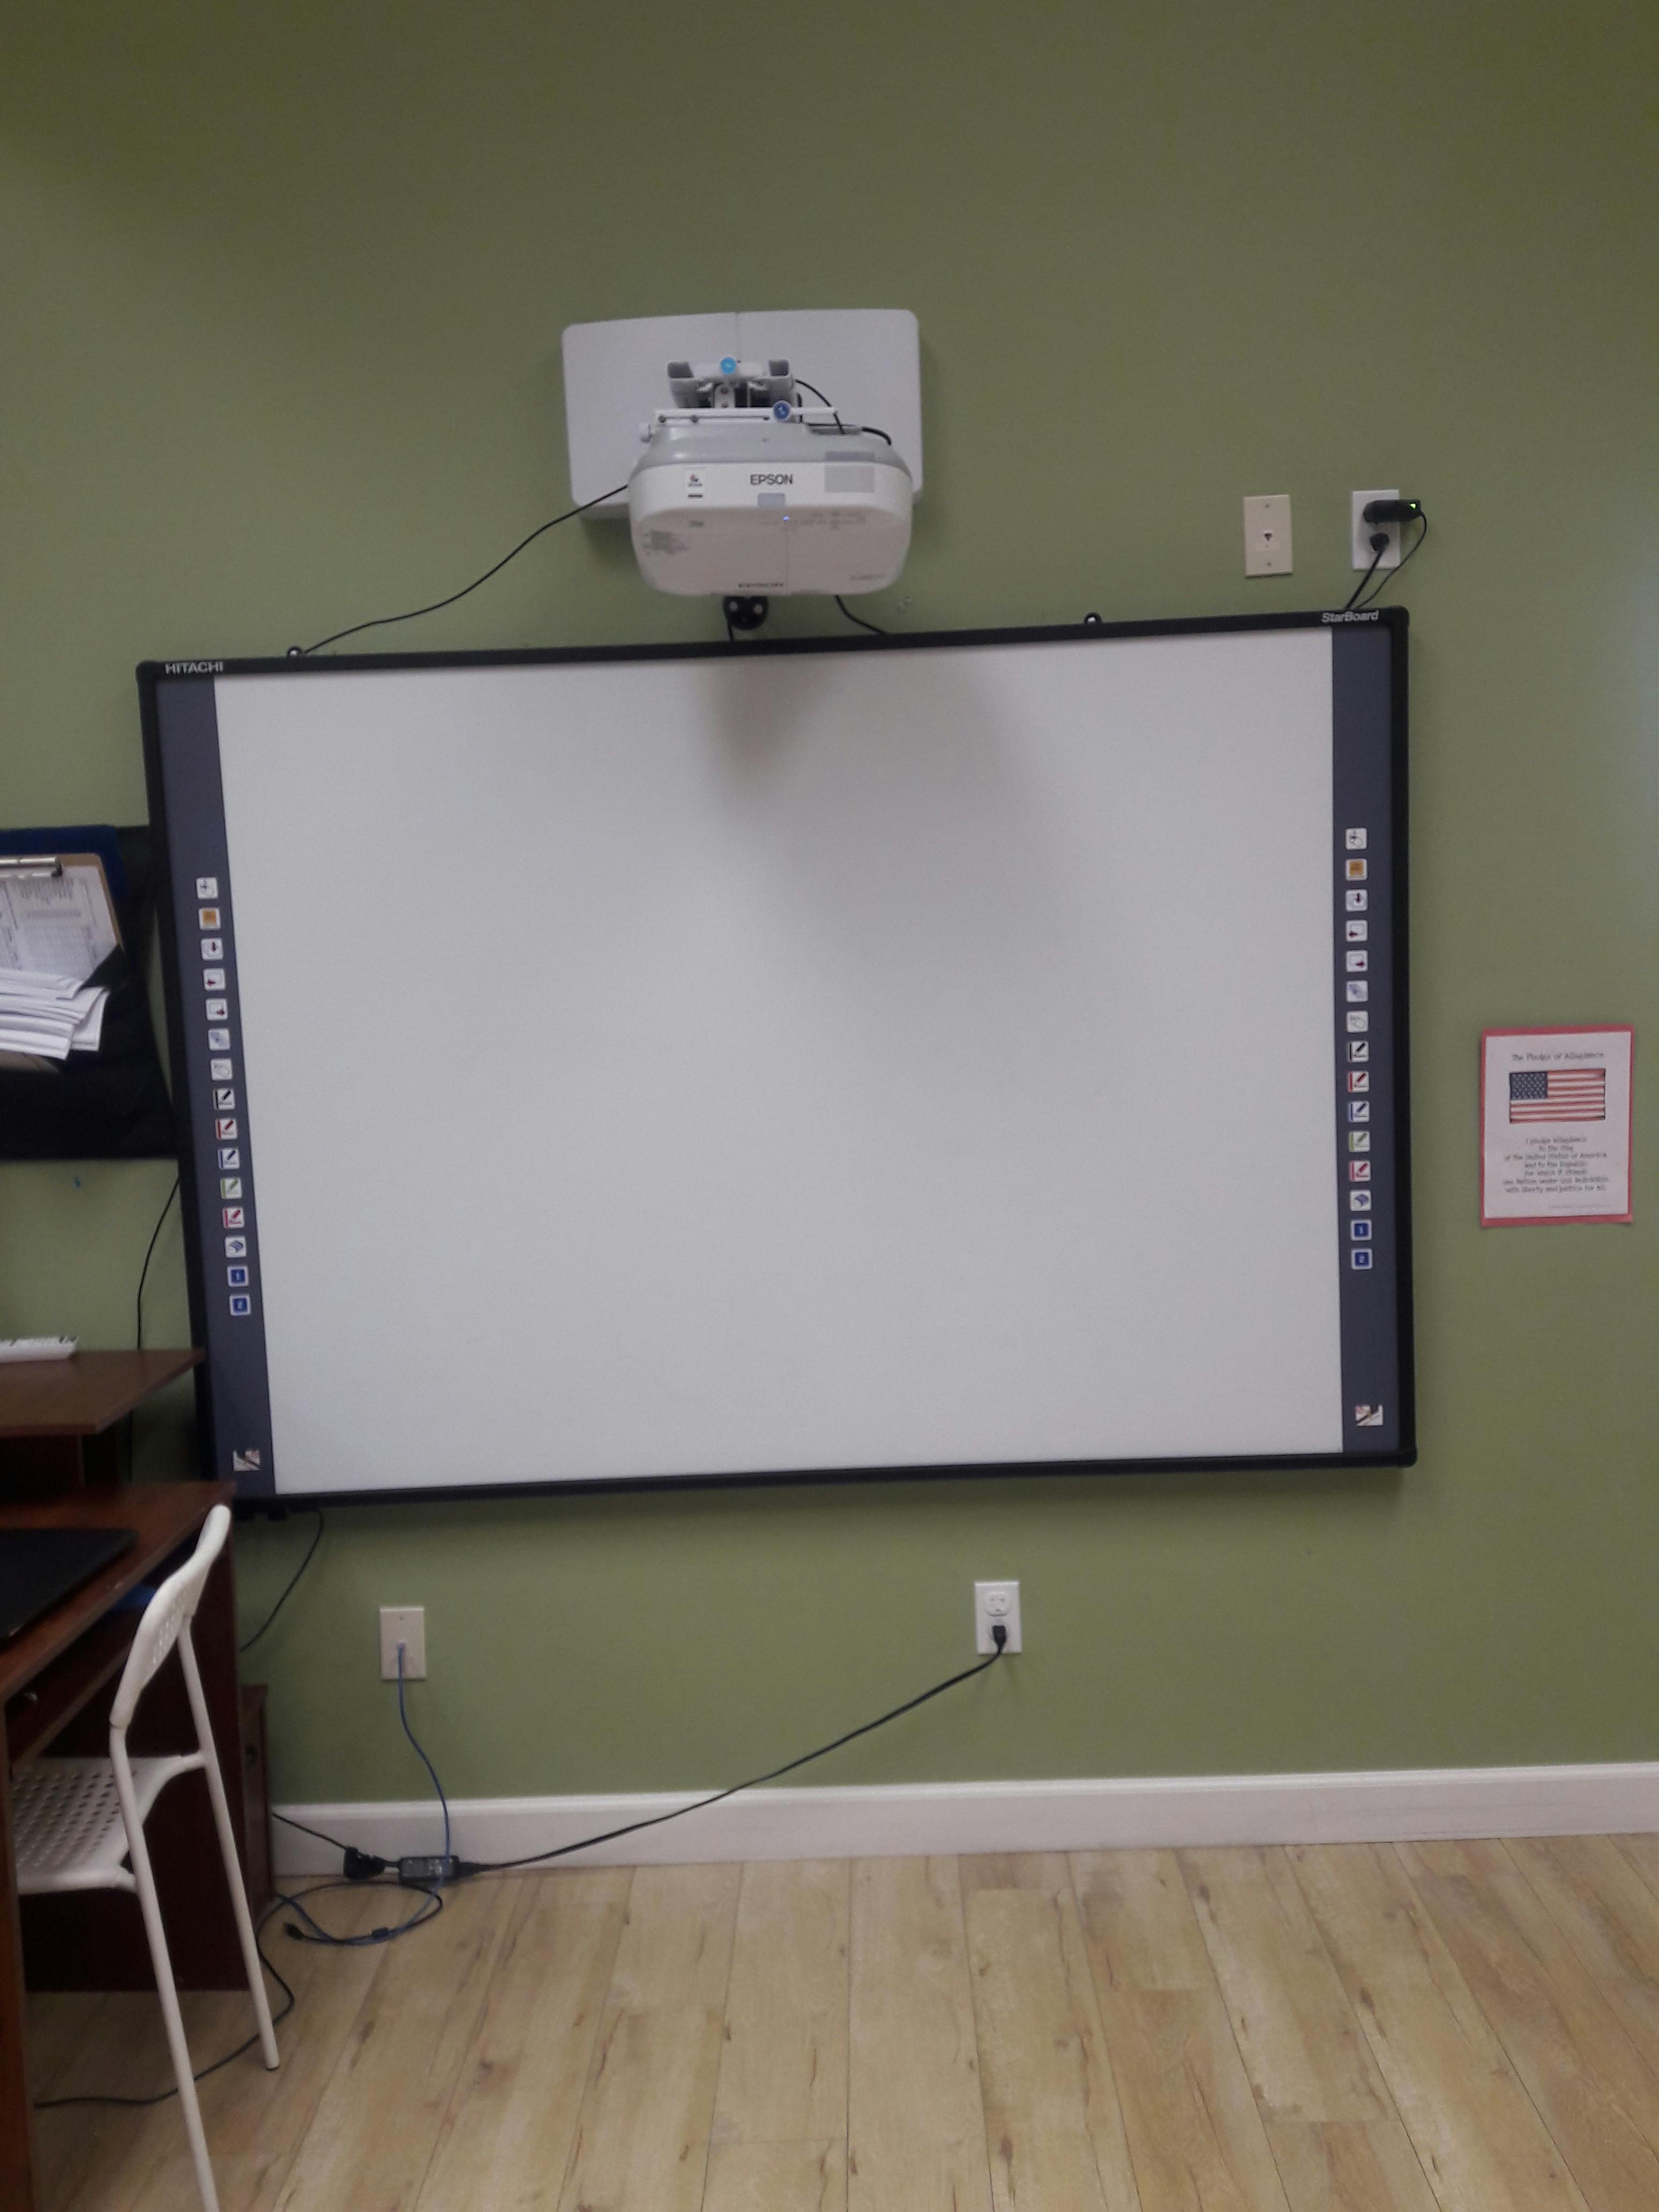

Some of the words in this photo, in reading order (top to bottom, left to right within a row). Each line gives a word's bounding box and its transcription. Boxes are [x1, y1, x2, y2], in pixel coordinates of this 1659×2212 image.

[750, 474, 793, 485] EPSON
[1321, 609, 1379, 623] StarBoard
[165, 661, 223, 675] HITACHI
